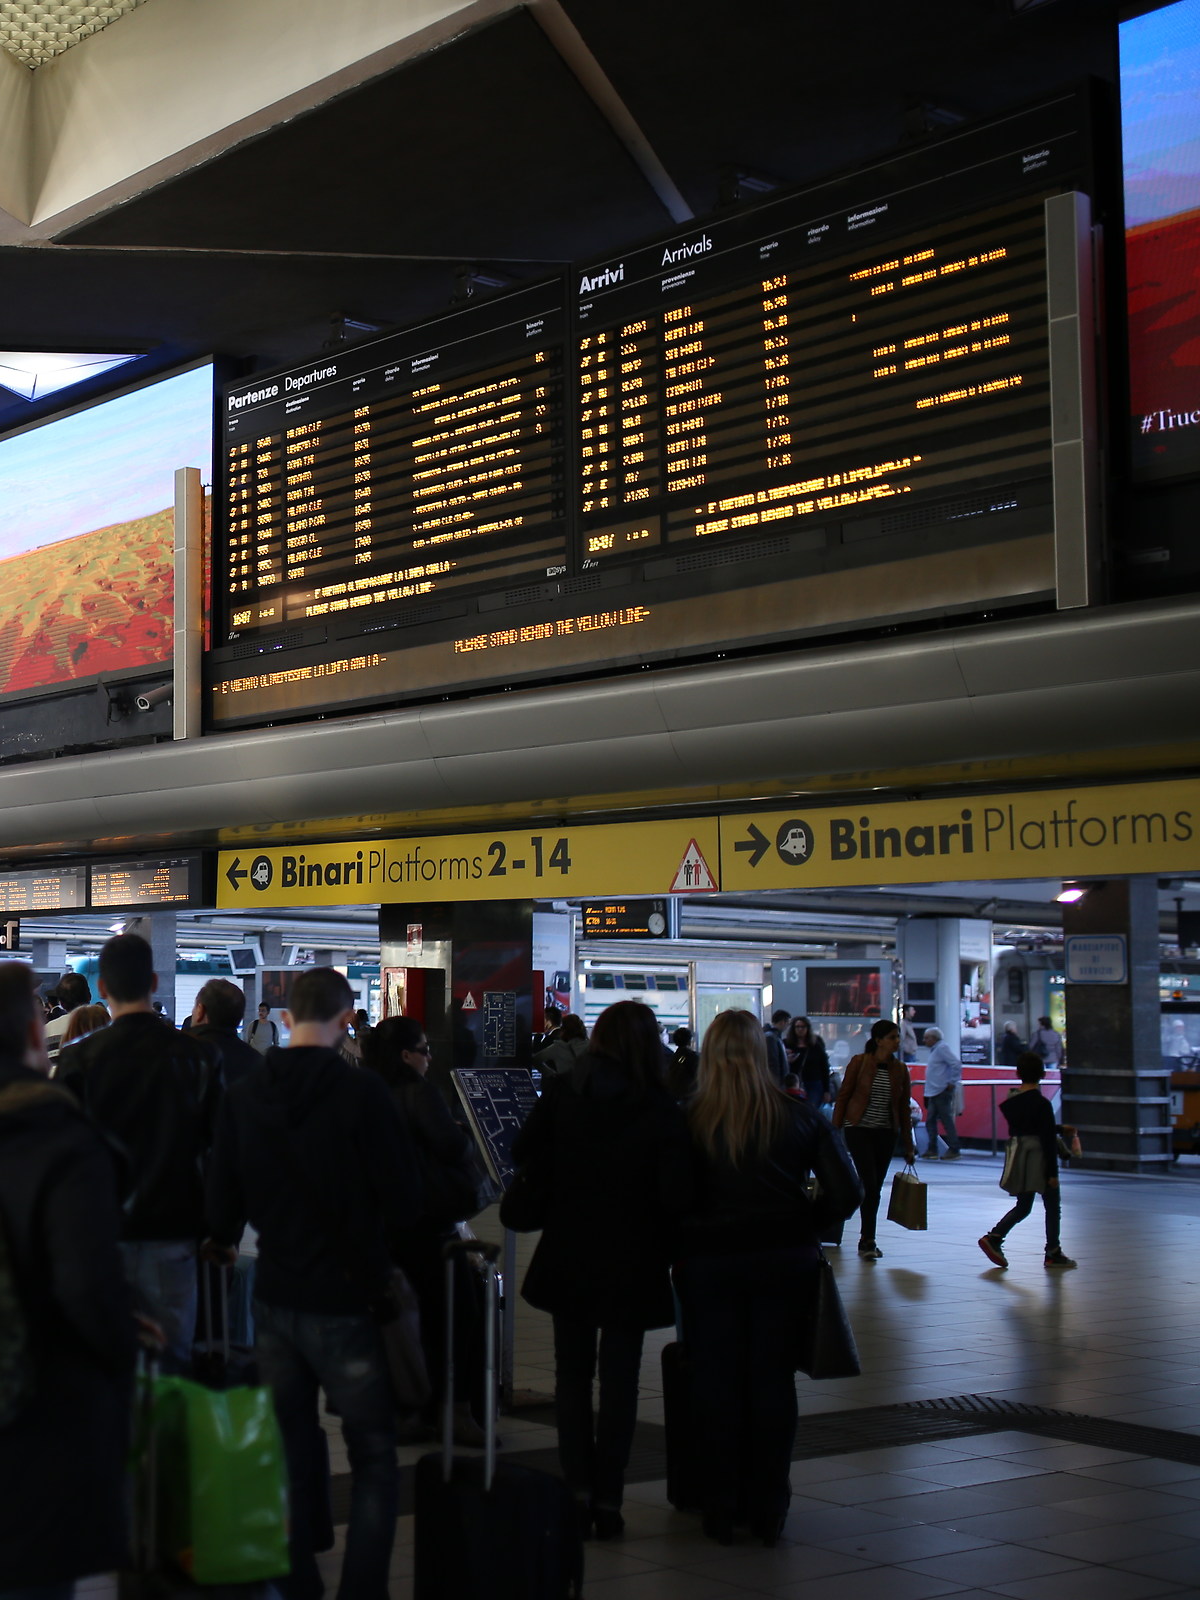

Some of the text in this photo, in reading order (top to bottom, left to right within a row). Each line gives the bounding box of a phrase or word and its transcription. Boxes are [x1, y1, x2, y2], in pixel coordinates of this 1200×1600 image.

[579, 234, 713, 295] Arrivi Arrivals
[661, 270, 696, 286] provenienza
[228, 366, 337, 411] Partenze Departures
[696, 519, 728, 536] PLEASE
[731, 512, 758, 528] STAND
[761, 504, 794, 522] BEHIND
[796, 500, 814, 514] THE
[817, 490, 858, 510] YELLOW
[719, 494, 755, 511] VIETATO
[828, 474, 840, 488] LA
[426, 560, 450, 576] GIALLA
[306, 602, 328, 618] PLEASE
[330, 598, 349, 612] STAND
[350, 594, 372, 608] BEHIND
[374, 590, 386, 604] THE
[387, 585, 414, 600] YELLOW
[454, 634, 488, 654] PLEASE
[490, 628, 518, 648] STAND
[520, 622, 554, 642] BEHIND
[556, 618, 574, 636] THE
[576, 611, 617, 632] YELLOW
[830, 800, 1193, 861] Binari Platforms
[282, 835, 572, 888] Binari Platforms 2-14
[781, 967, 800, 984] 13
